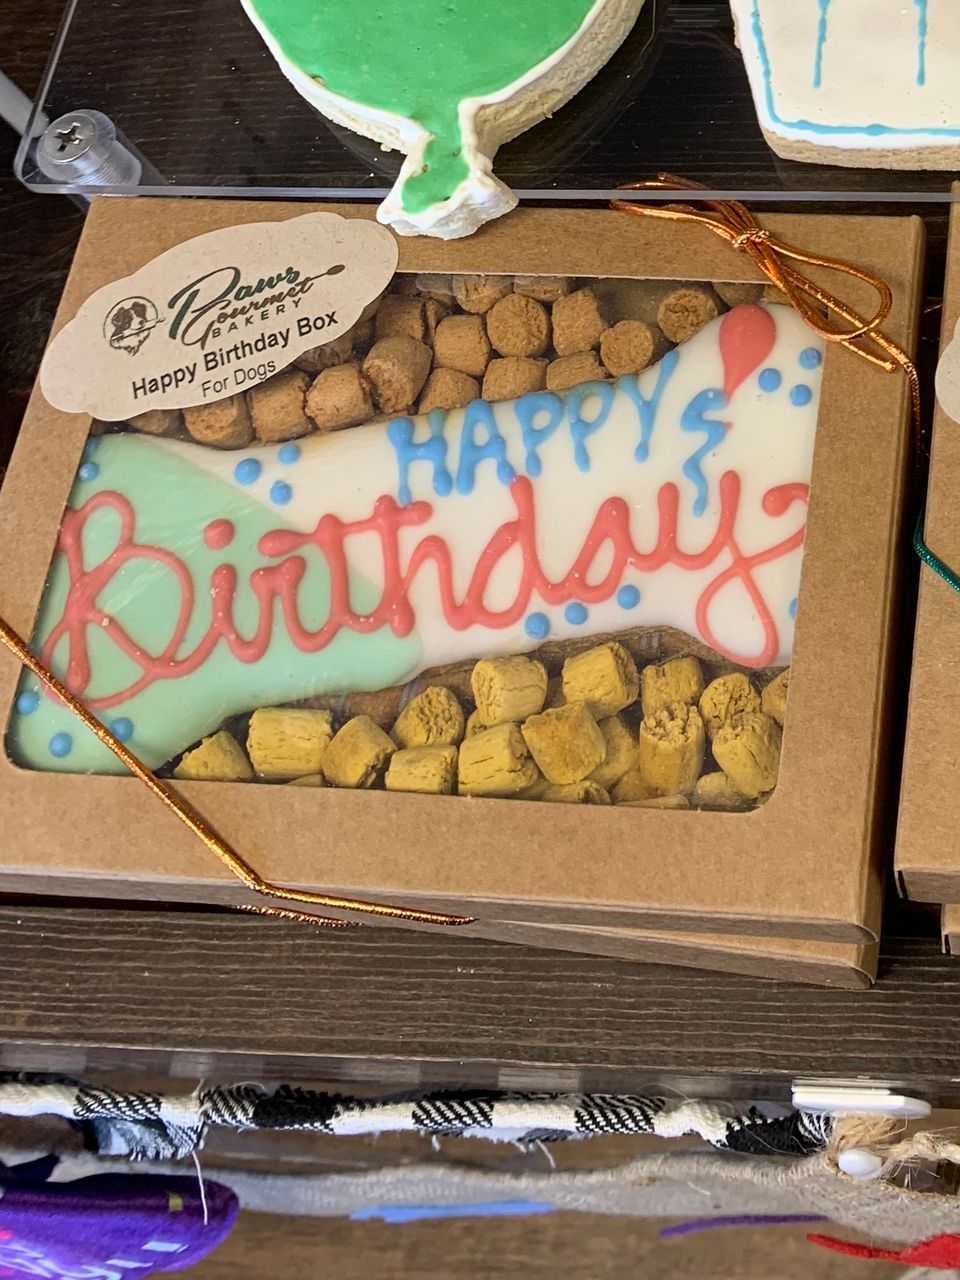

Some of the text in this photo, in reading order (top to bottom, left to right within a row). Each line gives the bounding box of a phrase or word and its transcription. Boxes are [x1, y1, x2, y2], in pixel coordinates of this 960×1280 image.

[168, 266, 301, 340] Paws
[181, 276, 316, 350] Gourmet
[212, 297, 303, 339] BAKERY
[131, 309, 340, 400] Happy Birthday Box
[201, 359, 277, 398] For Dogs
[387, 349, 680, 504] HAPPY
[42, 468, 810, 711] Birthday
